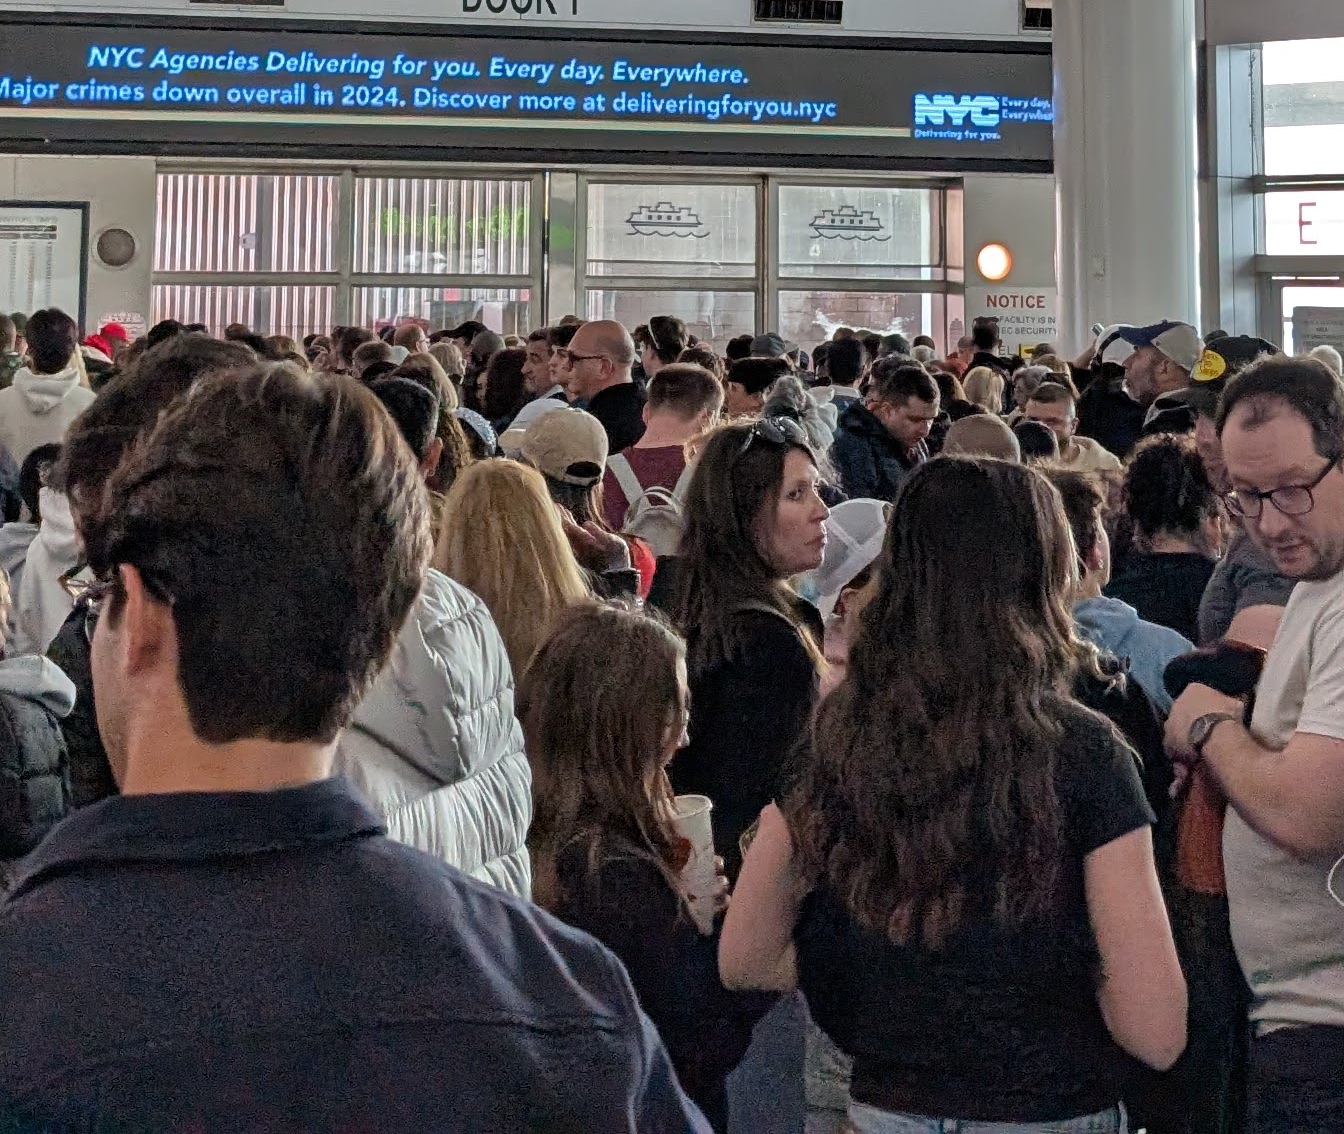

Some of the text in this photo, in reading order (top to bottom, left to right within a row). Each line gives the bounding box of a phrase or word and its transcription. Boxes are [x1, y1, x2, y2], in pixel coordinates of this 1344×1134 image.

[87, 45, 750, 87] NYC Agencies Delivering for you. Every day. Everywhere.
[65, 78, 145, 102] crimes
[152, 79, 219, 103] down
[226, 81, 306, 106] overall
[313, 82, 334, 106] in
[341, 84, 407, 108] 2024.
[413, 86, 513, 110] Discover
[518, 91, 576, 111] more
[582, 93, 606, 113] at
[612, 91, 838, 123] deliveringforyou.nyc
[1001, 96, 1029, 110] Every
[914, 93, 1000, 127] NYC
[986, 294, 1046, 309] NOTICE
[999, 315, 1036, 324] FACILITY
[1037, 316, 1046, 324] IS
[1014, 326, 1058, 335] SECURITY
